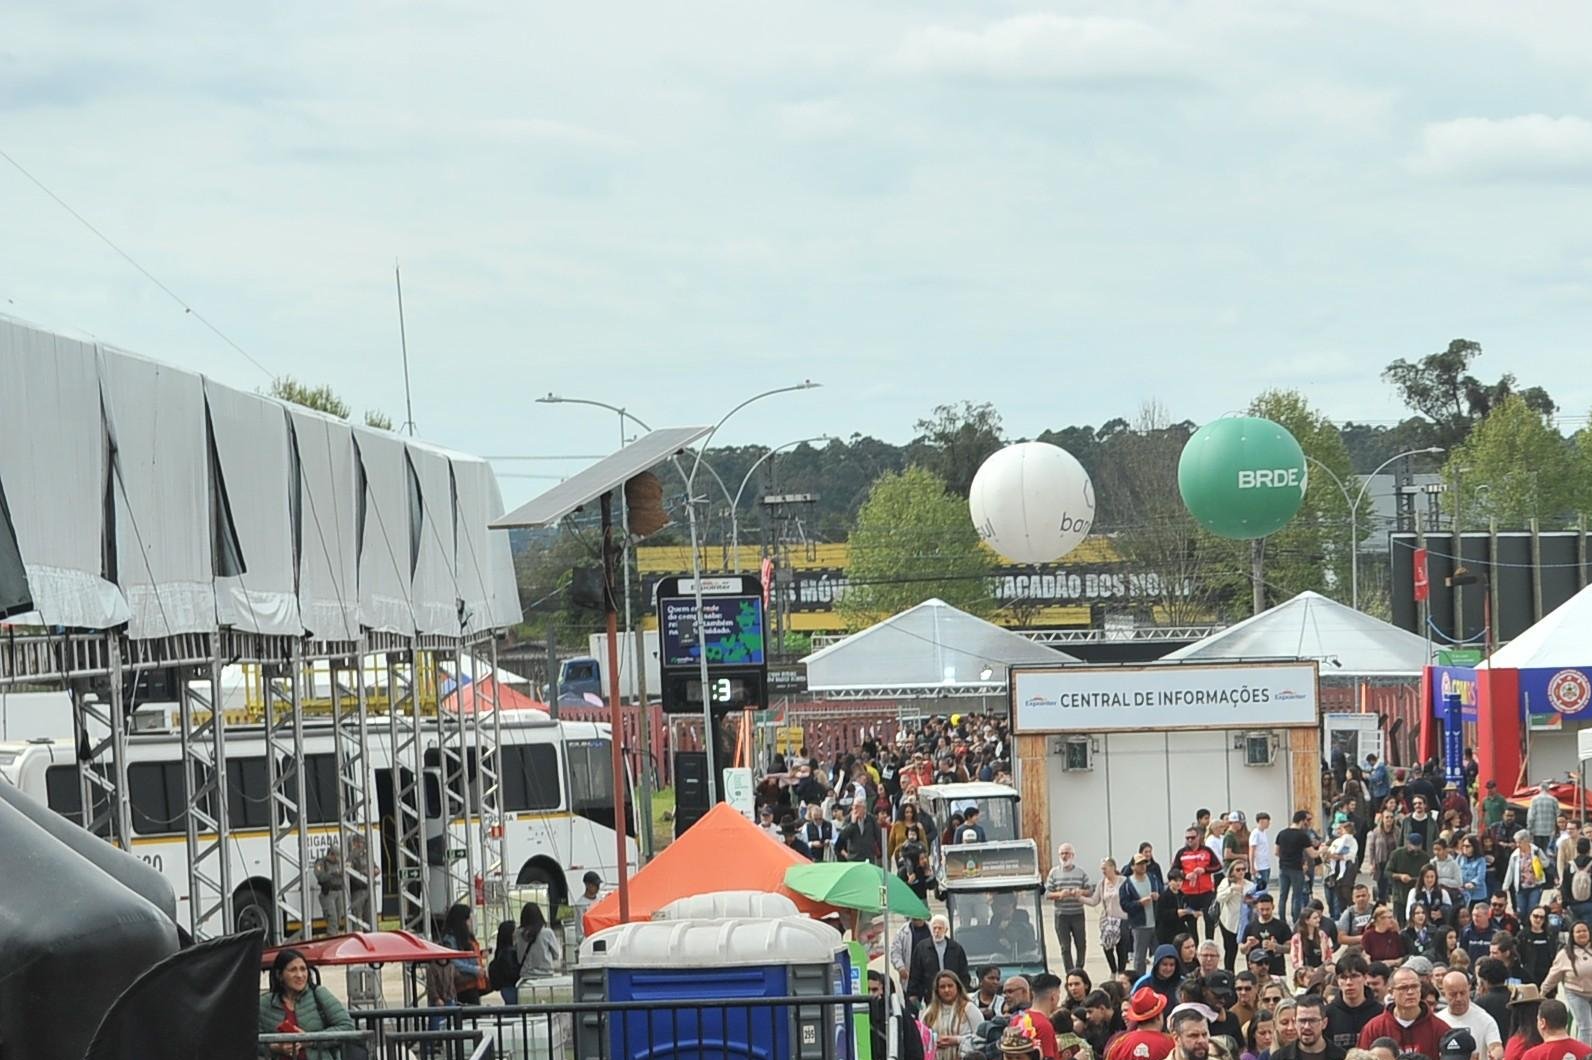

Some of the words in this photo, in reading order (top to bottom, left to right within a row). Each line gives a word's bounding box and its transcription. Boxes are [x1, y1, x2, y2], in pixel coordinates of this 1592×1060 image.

[1238, 468, 1299, 488] BRDE
[1060, 691, 1131, 708] CENTRAL
[1134, 690, 1154, 706] DE
[1158, 685, 1270, 708] INFORMAÇÕES
